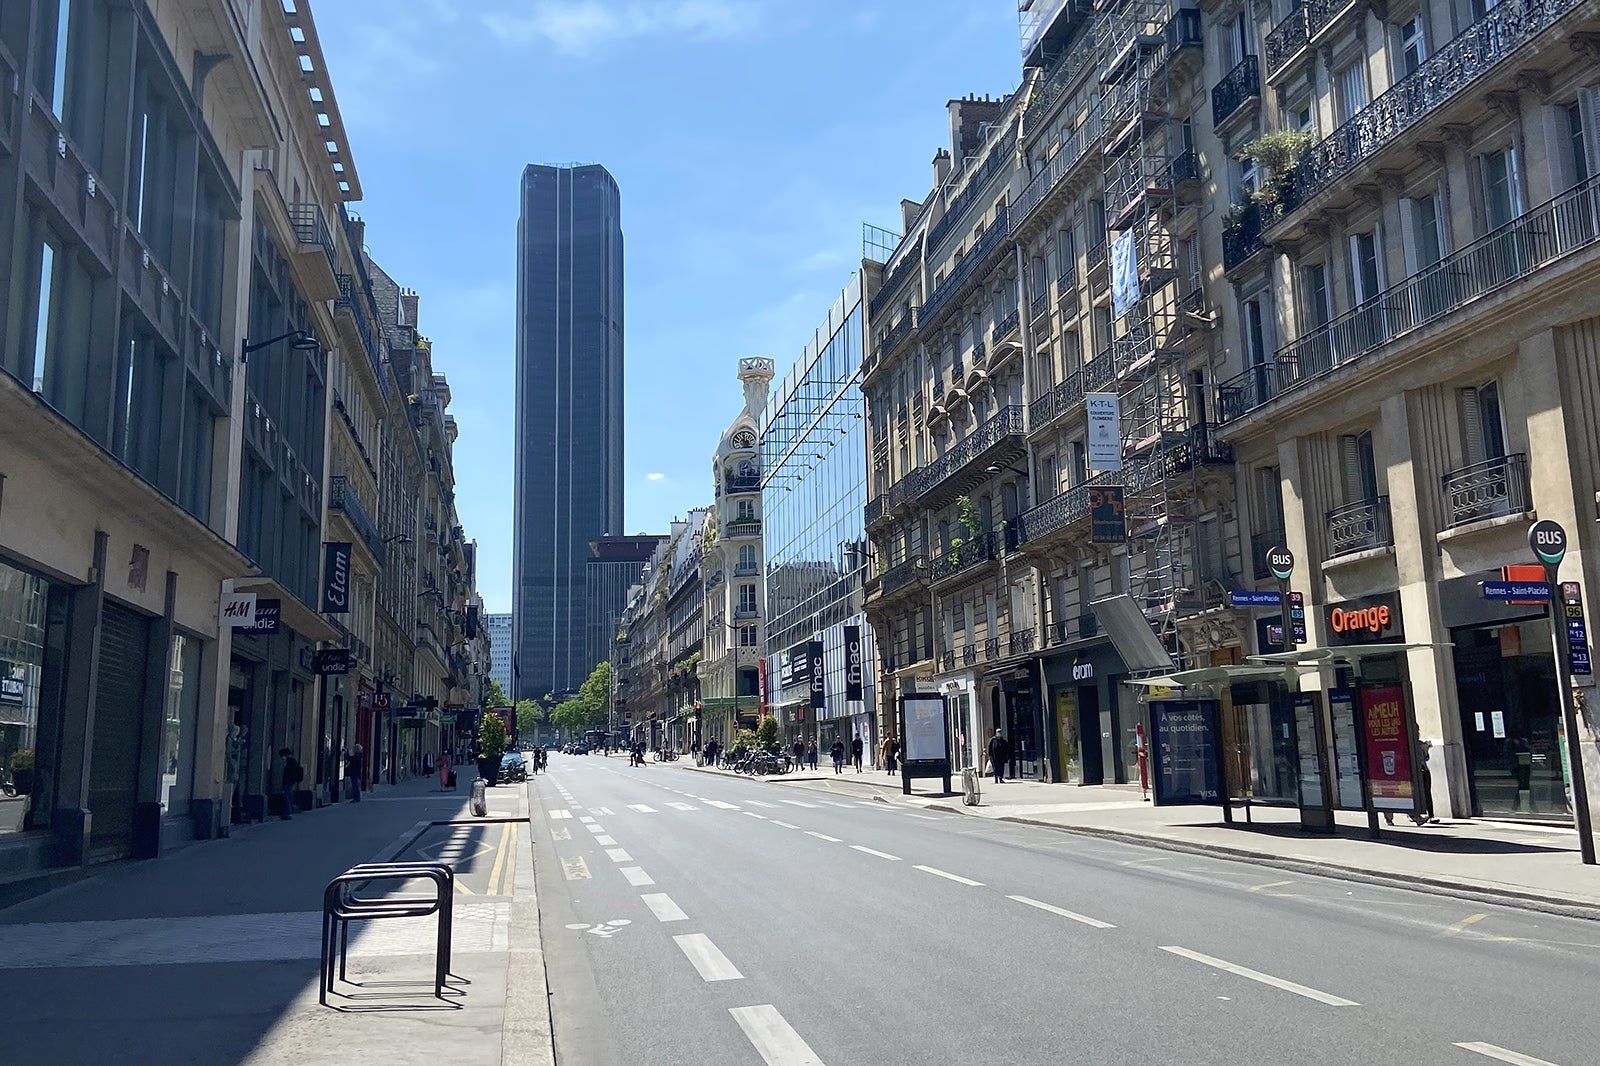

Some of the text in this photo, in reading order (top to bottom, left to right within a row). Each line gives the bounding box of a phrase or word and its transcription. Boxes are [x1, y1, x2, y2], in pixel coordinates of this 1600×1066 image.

[1537, 531, 1562, 544] BUS
[1272, 554, 1291, 565] BUS
[327, 551, 346, 606] Etam
[1485, 586, 1507, 595] Rennes
[1511, 586, 1549, 595] Saint-Placide
[1564, 584, 1578, 594] 94
[255, 607, 279, 615] am
[1567, 607, 1581, 616] 96
[1331, 604, 1389, 633] Orange
[322, 663, 346, 671] undiz
[847, 641, 860, 685] fnac
[811, 656, 822, 693] fnac
[1170, 723, 1209, 734] quotidien.
[1200, 790, 1217, 798] VISA
